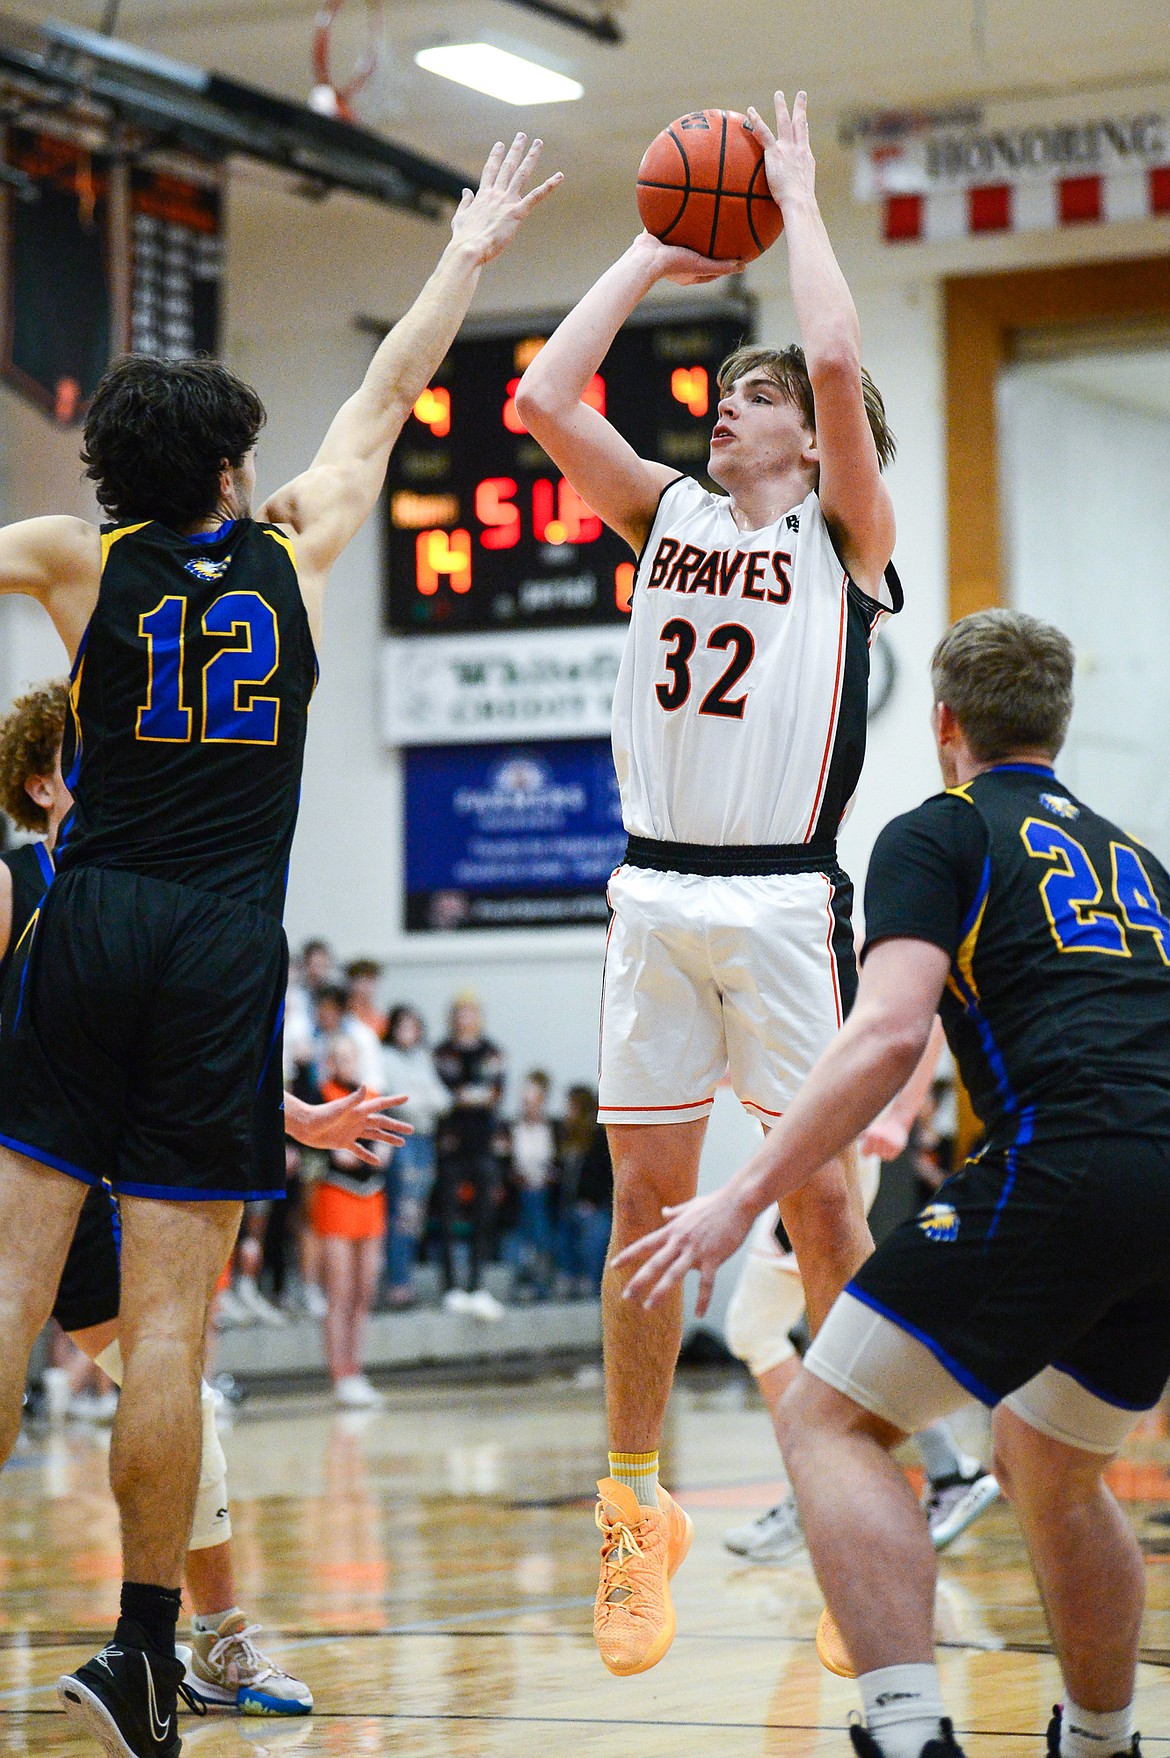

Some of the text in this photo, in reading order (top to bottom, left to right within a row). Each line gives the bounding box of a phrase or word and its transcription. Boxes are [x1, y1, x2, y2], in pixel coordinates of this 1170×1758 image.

[647, 536, 792, 606] BRAVES
[135, 590, 280, 746] 12
[655, 617, 755, 720] 32
[1019, 816, 1170, 966] 24
